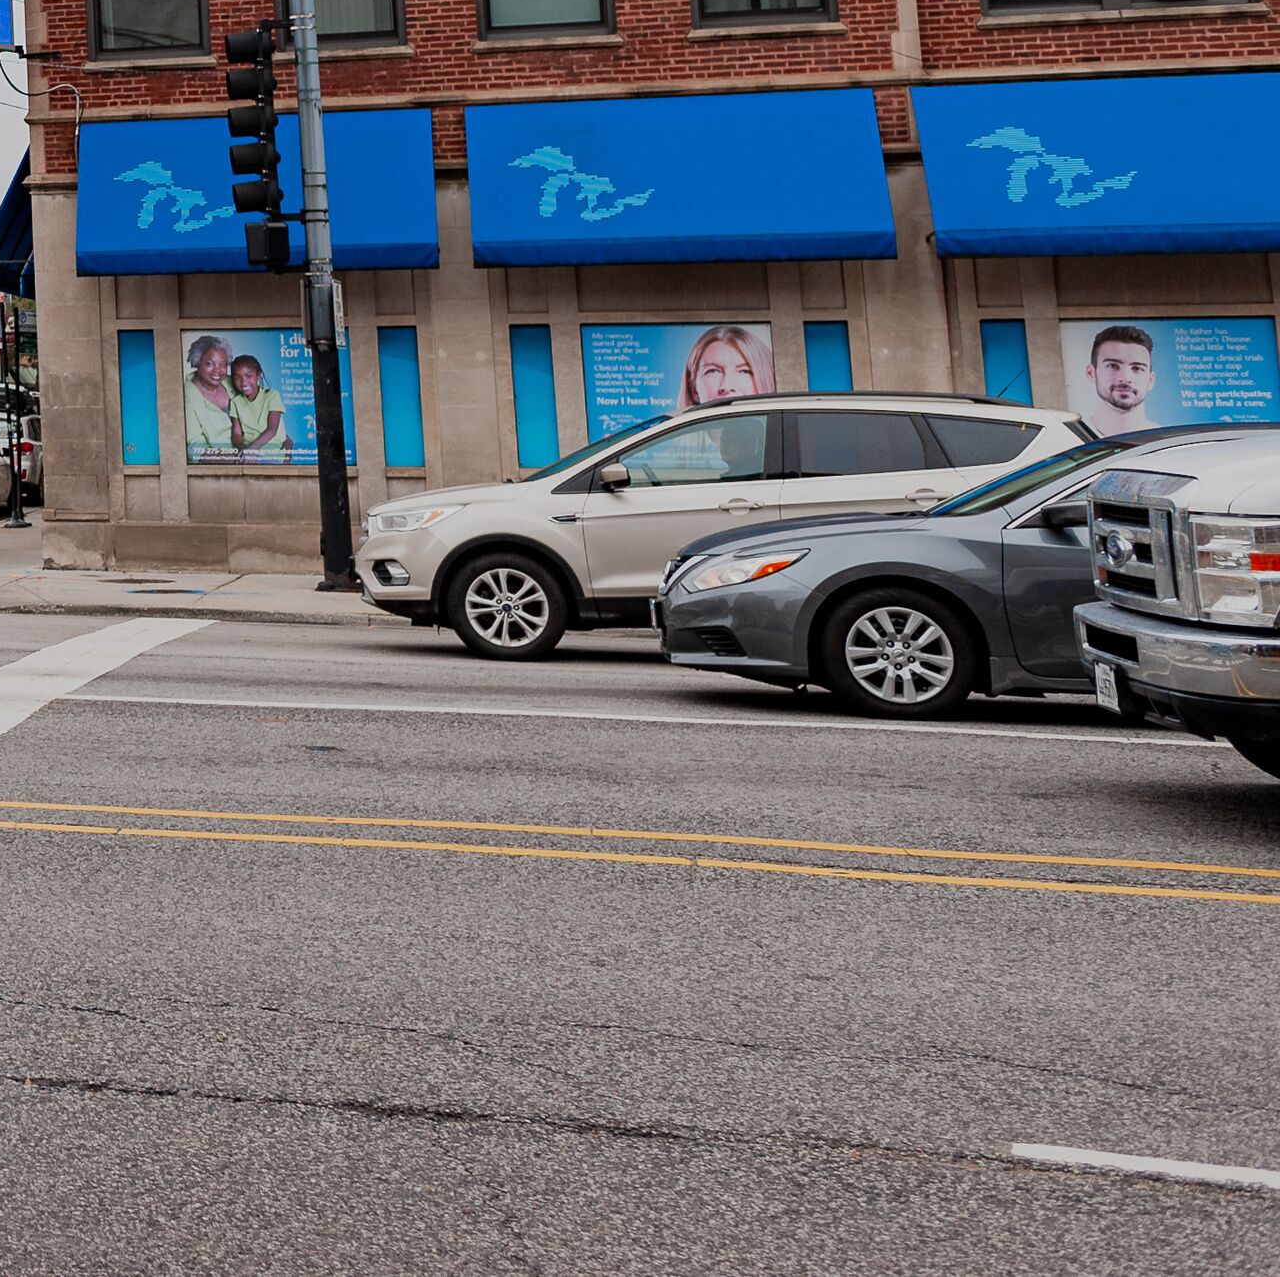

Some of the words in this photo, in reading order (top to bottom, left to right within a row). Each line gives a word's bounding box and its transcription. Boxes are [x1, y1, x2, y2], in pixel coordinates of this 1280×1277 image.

[281, 345, 300, 357] for
[1181, 390, 1197, 398] We
[1215, 390, 1272, 399] participating
[596, 397, 618, 405] Now
[621, 397, 625, 405] I
[627, 396, 648, 405] have
[650, 396, 674, 407] hope.
[1194, 399, 1213, 409] help
[1216, 399, 1234, 408] find
[1244, 400, 1266, 408] cure.
